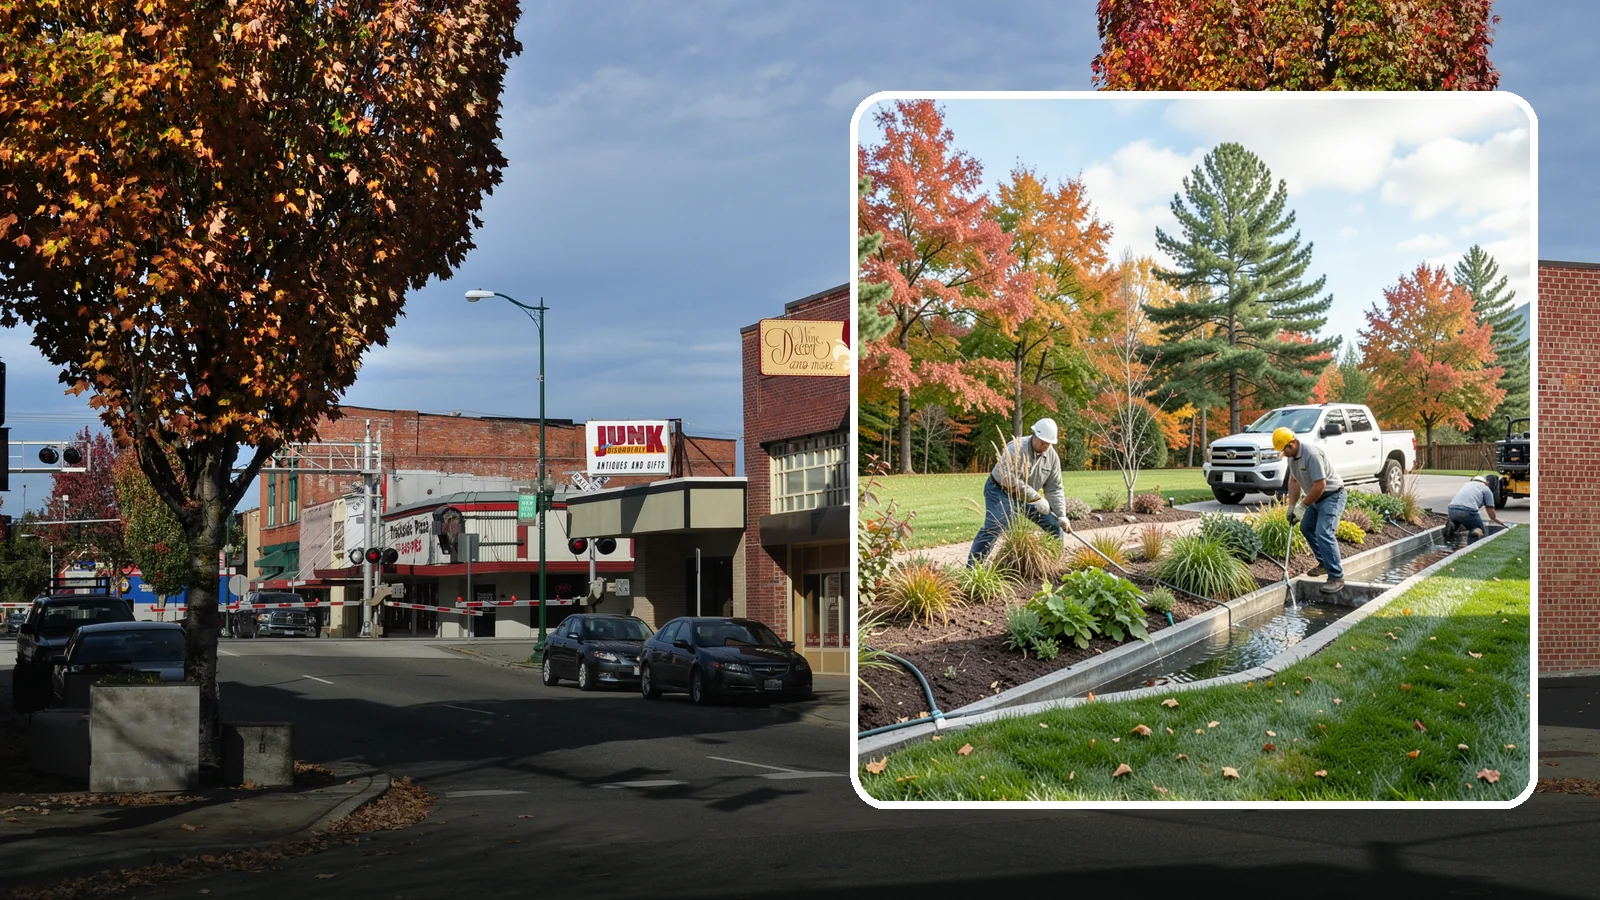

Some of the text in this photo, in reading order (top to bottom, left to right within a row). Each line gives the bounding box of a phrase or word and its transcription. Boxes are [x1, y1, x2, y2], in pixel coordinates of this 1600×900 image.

[595, 425, 665, 457] JUNK
[607, 446, 646, 454] DISORDERLY
[597, 460, 665, 470] ANTIQUES AND GIFTS
